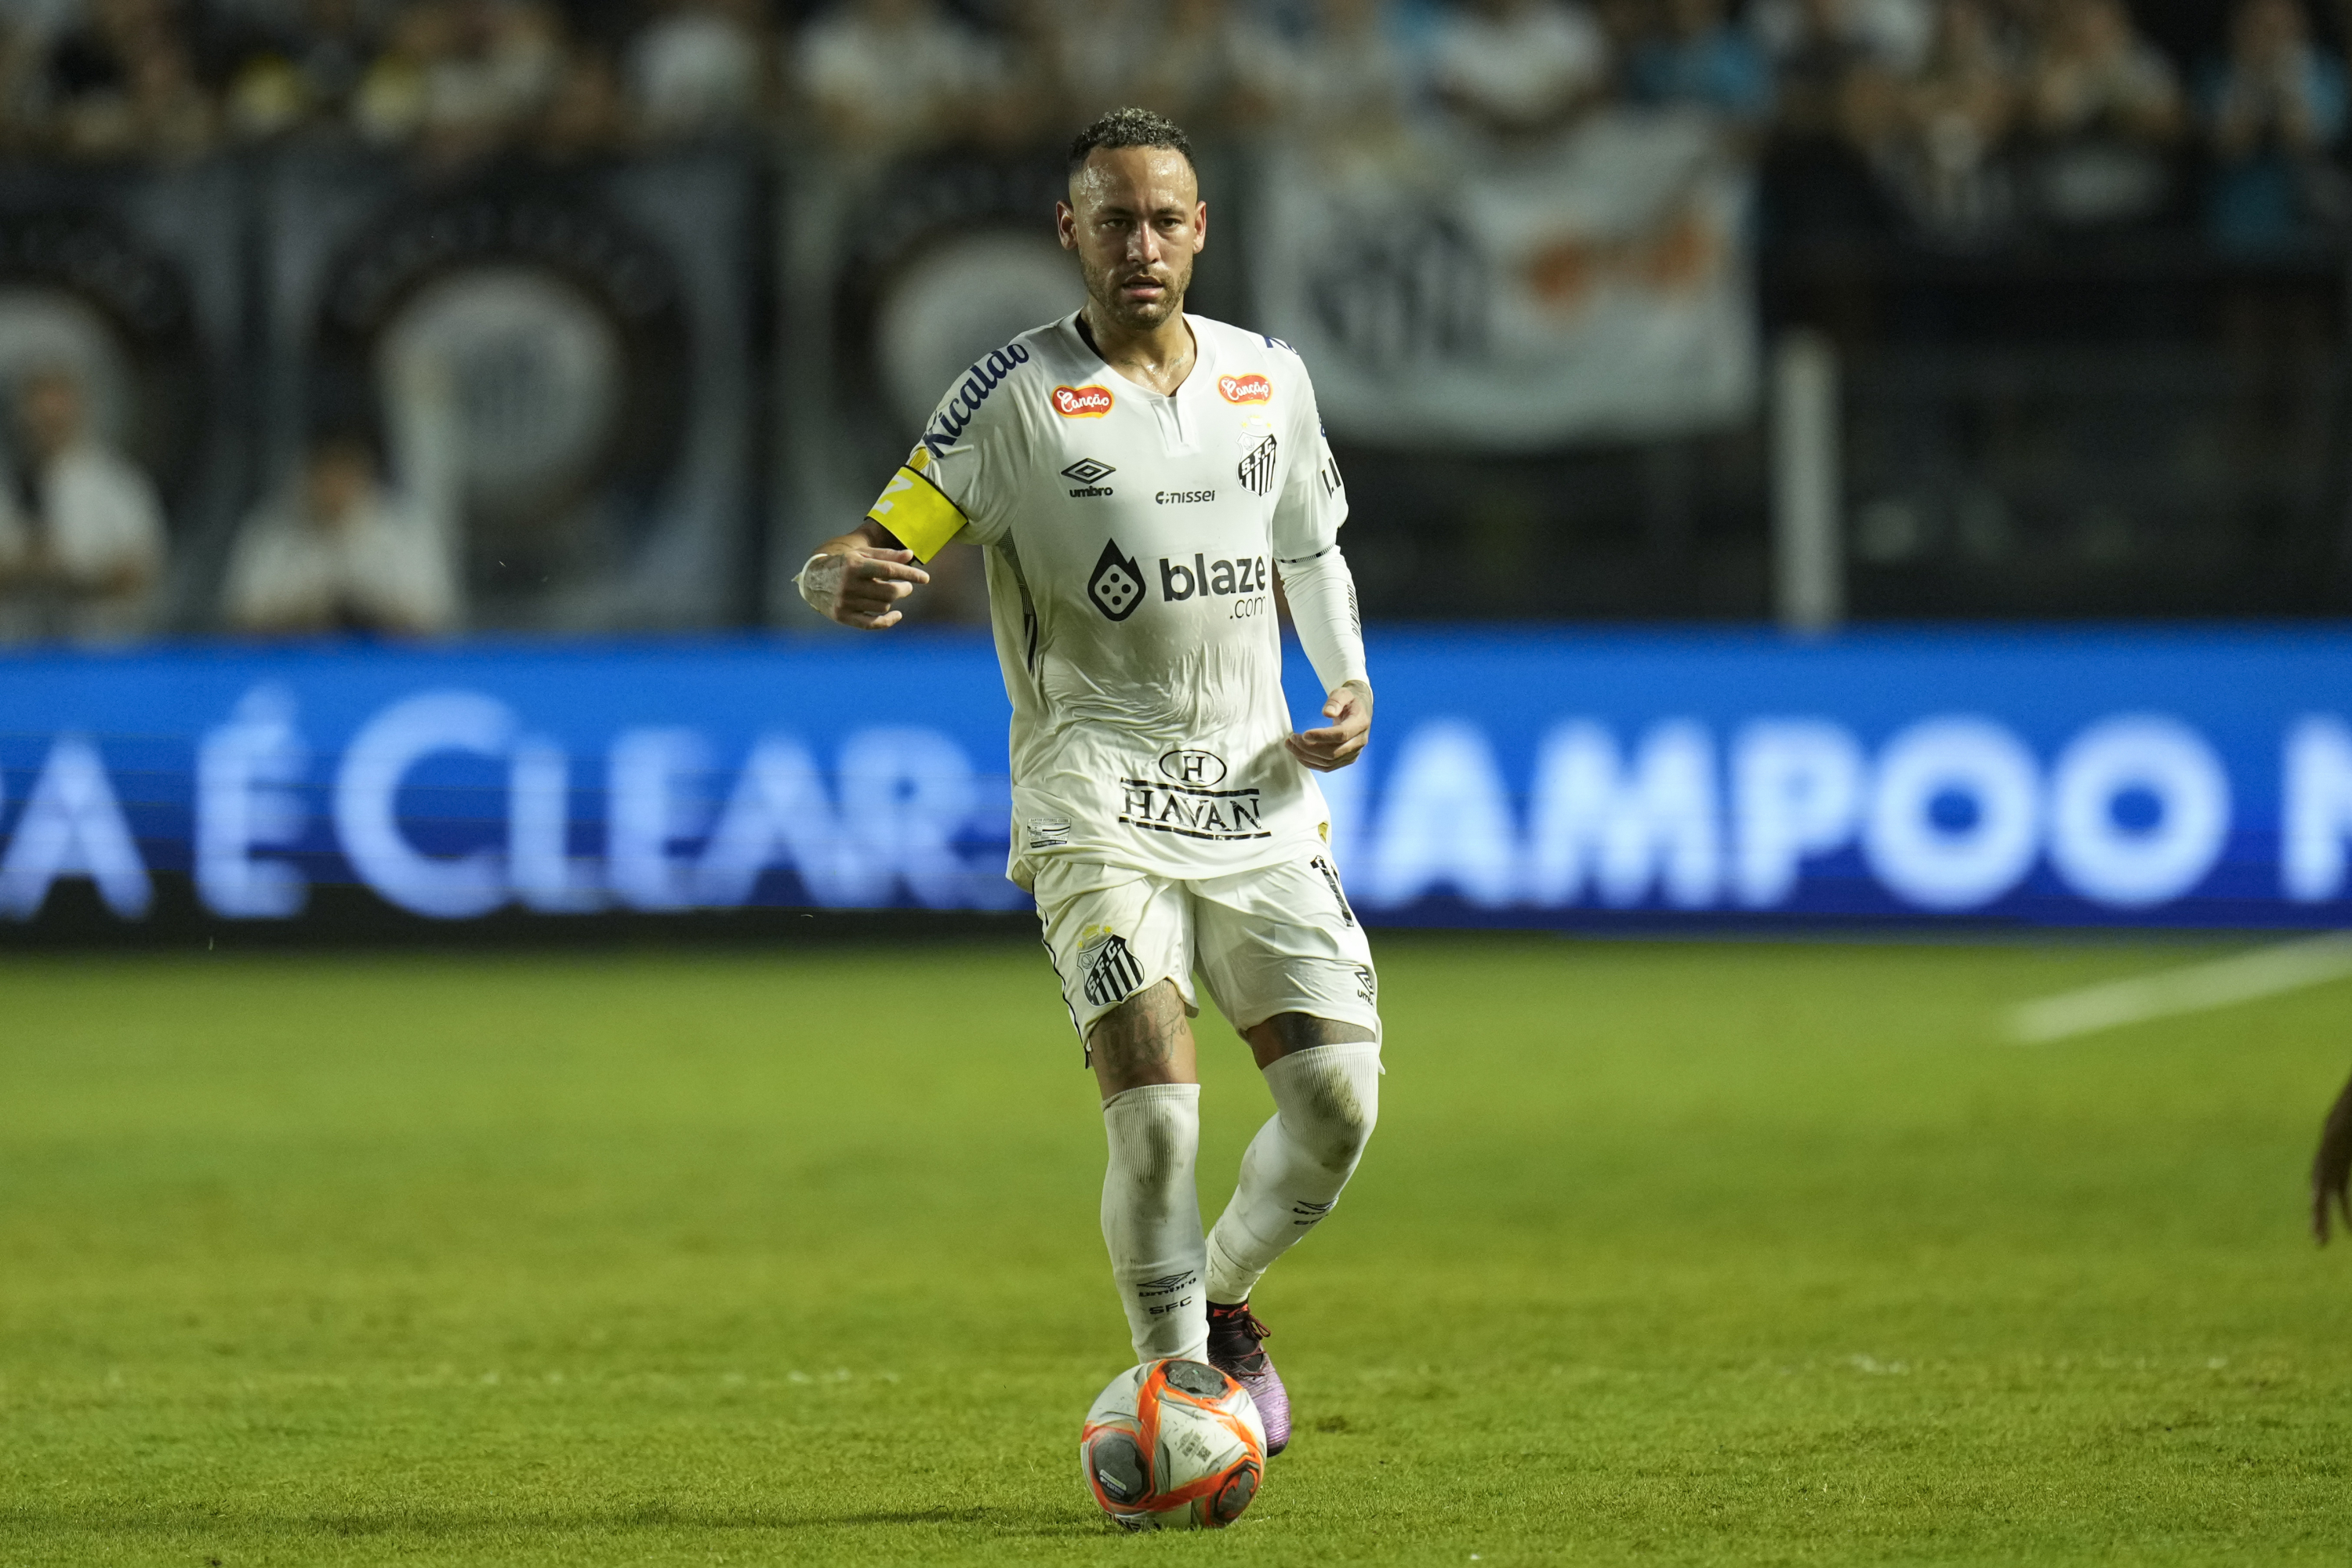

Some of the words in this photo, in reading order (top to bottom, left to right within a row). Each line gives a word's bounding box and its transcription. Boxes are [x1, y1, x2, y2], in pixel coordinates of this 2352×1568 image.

[923, 343, 1029, 459] Kicaldo
[1056, 389, 1110, 412] Canção
[1069, 485, 1113, 498] umbro
[1159, 553, 1265, 602] blaze
[1229, 596, 1267, 619] .com
[1180, 755, 1205, 782] H
[194, 681, 312, 919] É
[1311, 712, 2233, 913] AMPOO
[1122, 786, 1263, 832] HAVAN
[1149, 1296, 1192, 1315] SFC
